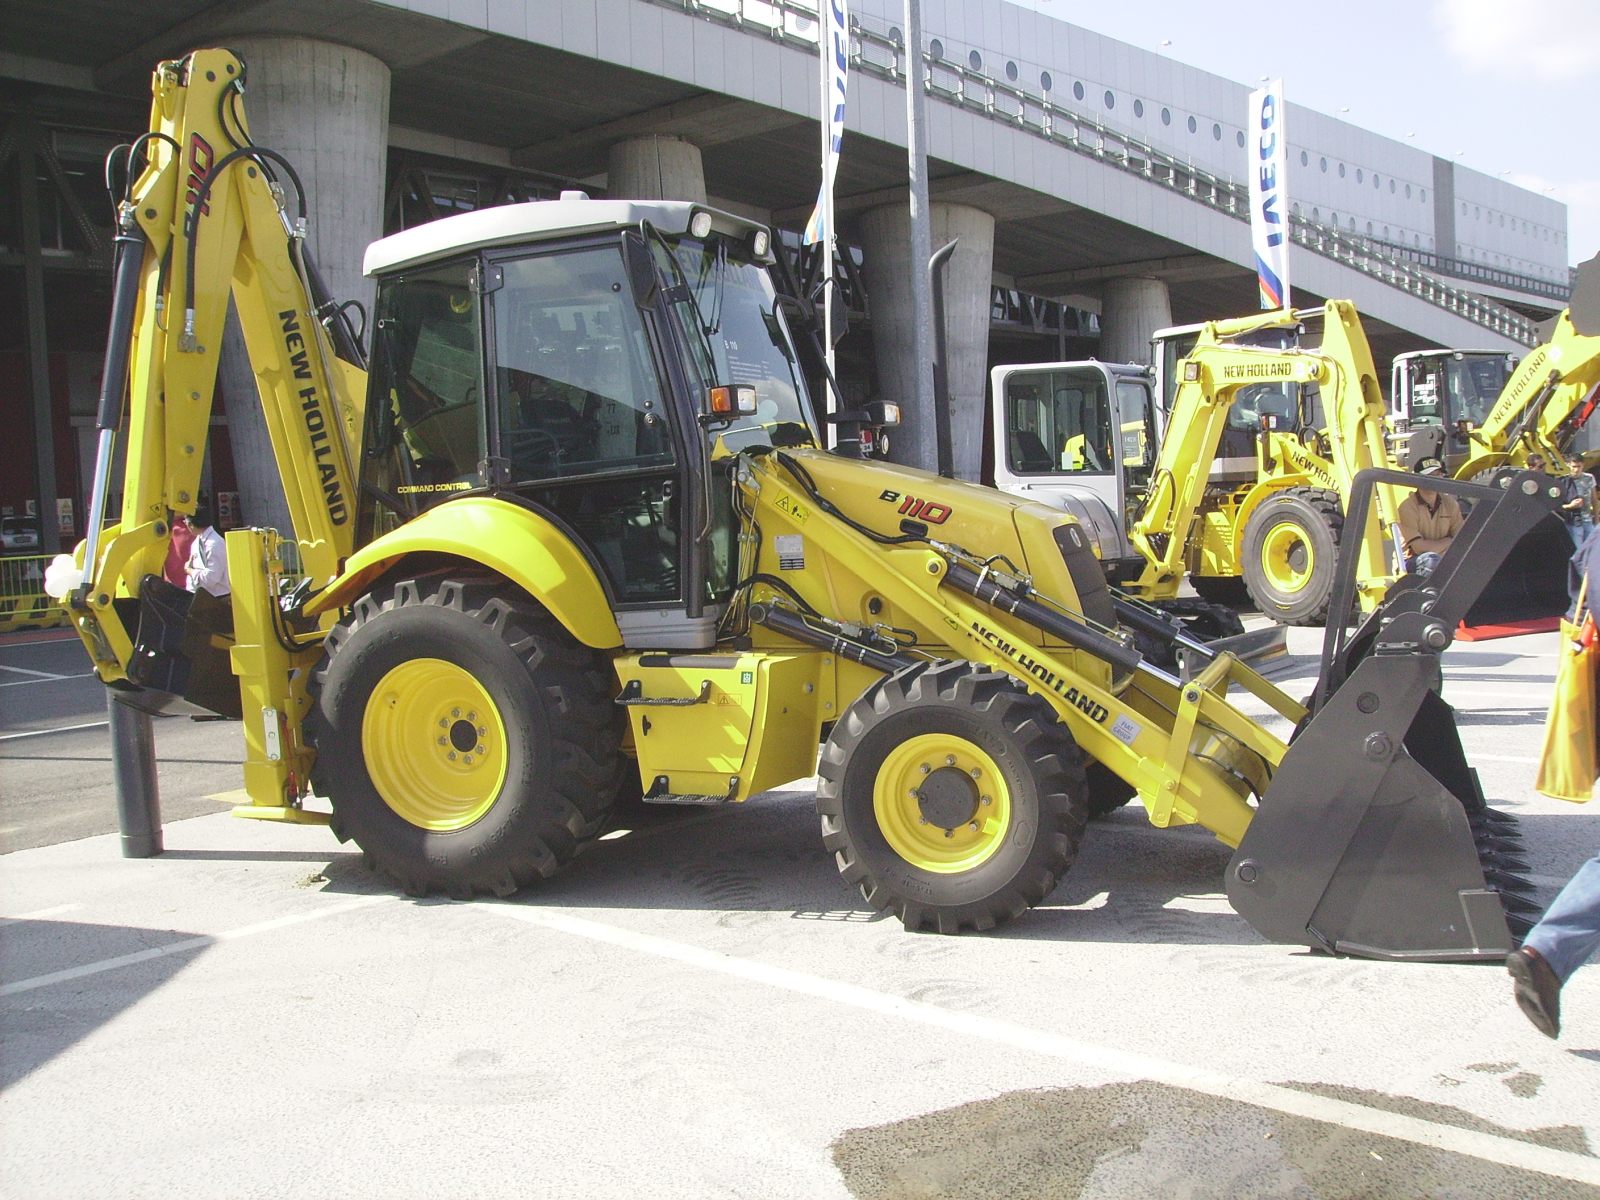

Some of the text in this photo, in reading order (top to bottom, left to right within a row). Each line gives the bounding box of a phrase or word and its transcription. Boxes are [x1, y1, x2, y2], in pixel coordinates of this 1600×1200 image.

[1259, 94, 1284, 248] IVECO
[1223, 362, 1292, 379] NEW HOLLAND
[1493, 351, 1547, 424] NEW HOLLAND
[278, 309, 348, 527] NEW HOLLAND
[397, 481, 473, 494] COMMAND CONTROL
[1291, 451, 1340, 492] NEW HOLL
[966, 621, 1110, 725] NEW HOLLAND
[1111, 720, 1134, 741] FIAT GROUP
